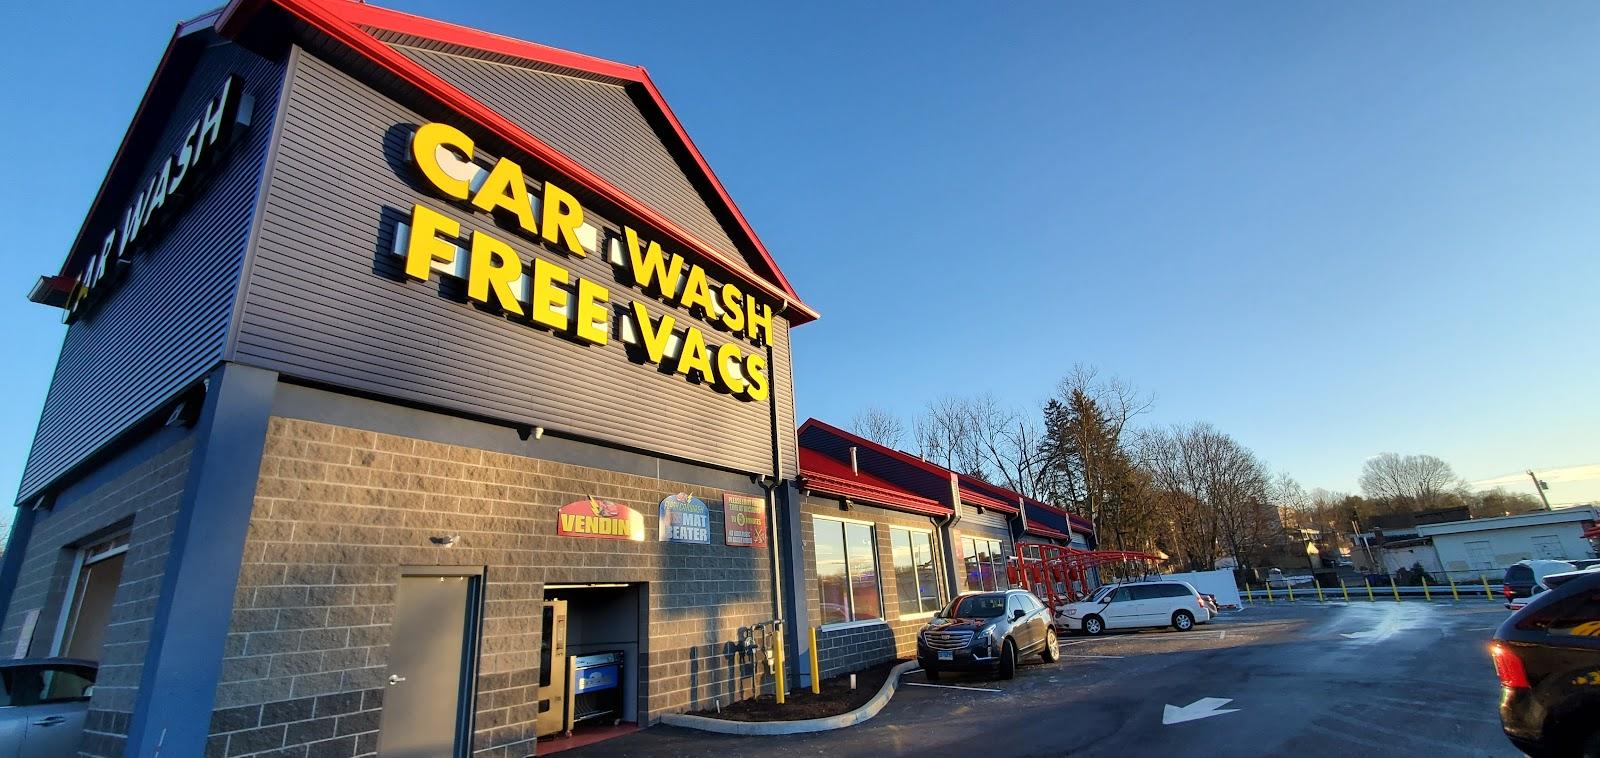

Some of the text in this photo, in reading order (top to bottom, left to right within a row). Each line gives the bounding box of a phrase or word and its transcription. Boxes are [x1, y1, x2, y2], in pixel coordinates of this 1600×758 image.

[118, 76, 232, 257] WASH
[412, 122, 773, 346] CAR WASH
[405, 204, 769, 401] FREE VACS
[561, 513, 632, 536] VENDIN
[682, 512, 707, 528] MAT
